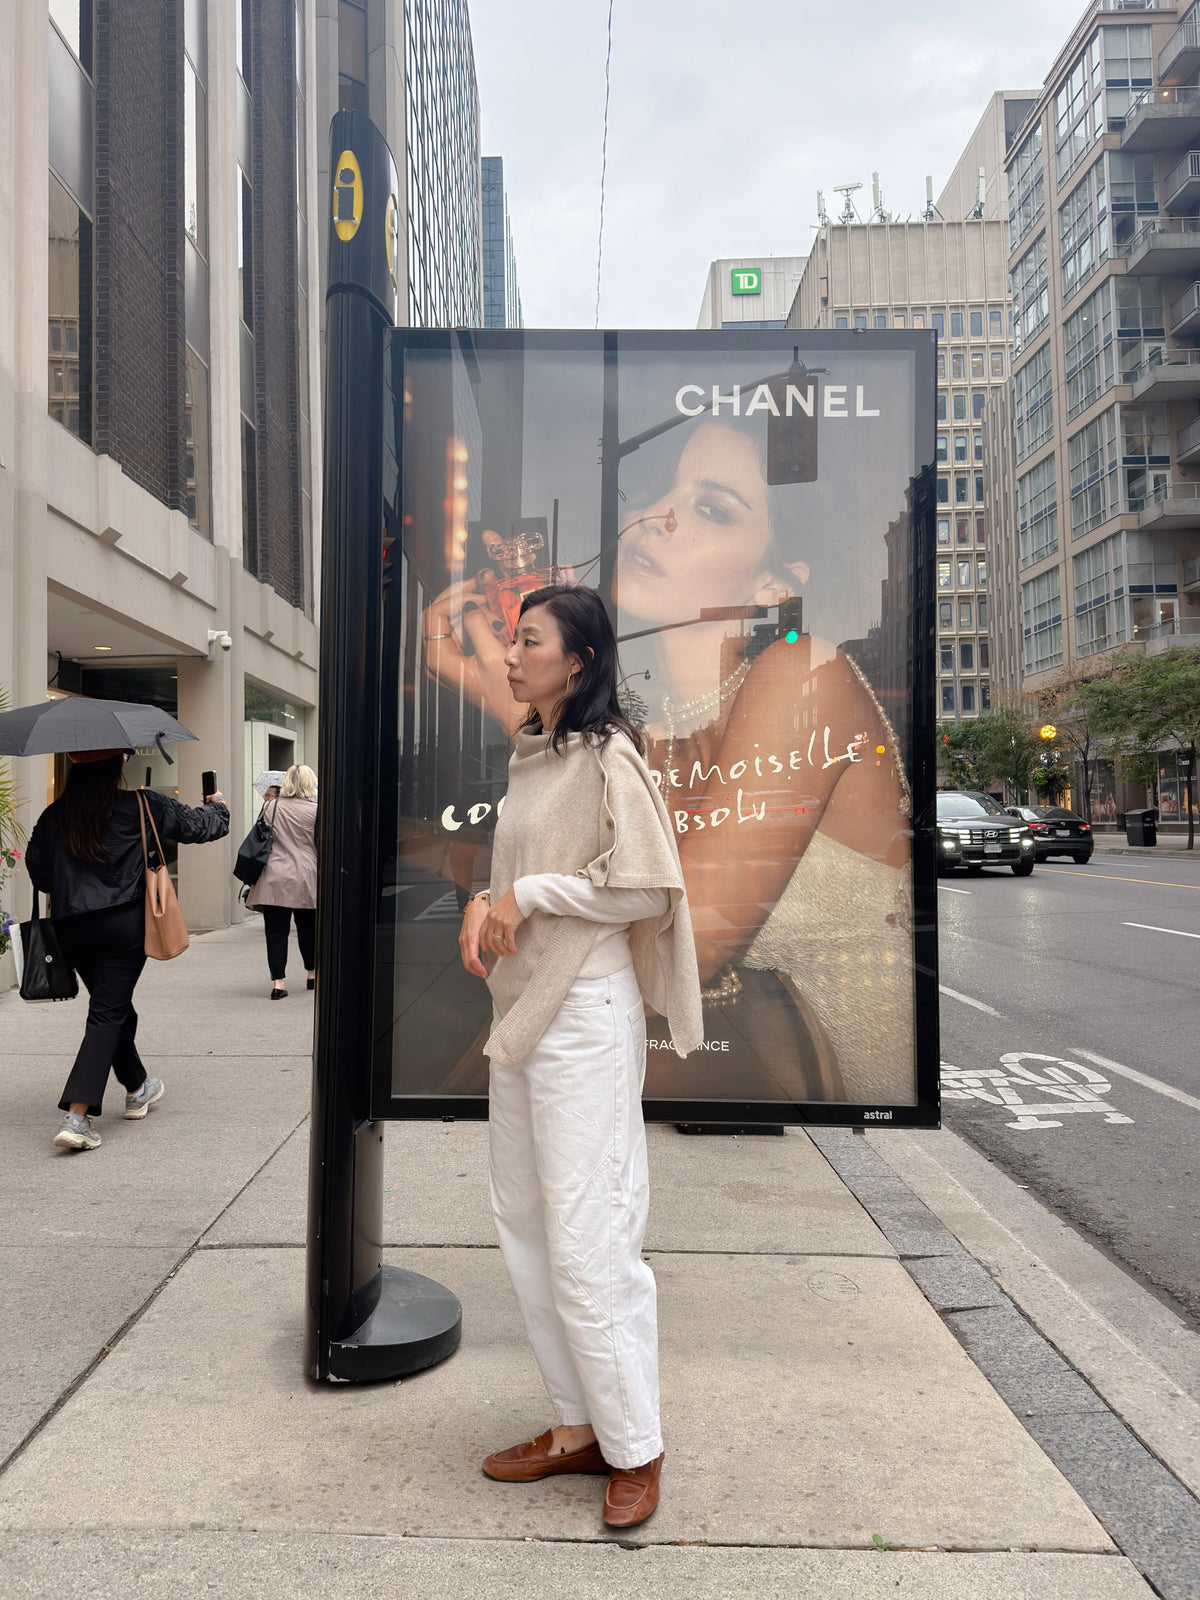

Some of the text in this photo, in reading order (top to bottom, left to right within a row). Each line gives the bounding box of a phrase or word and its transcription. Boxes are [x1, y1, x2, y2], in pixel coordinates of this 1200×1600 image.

[734, 273, 759, 290] TD
[675, 384, 881, 418] CHANEL
[863, 1110, 893, 1120] astral
